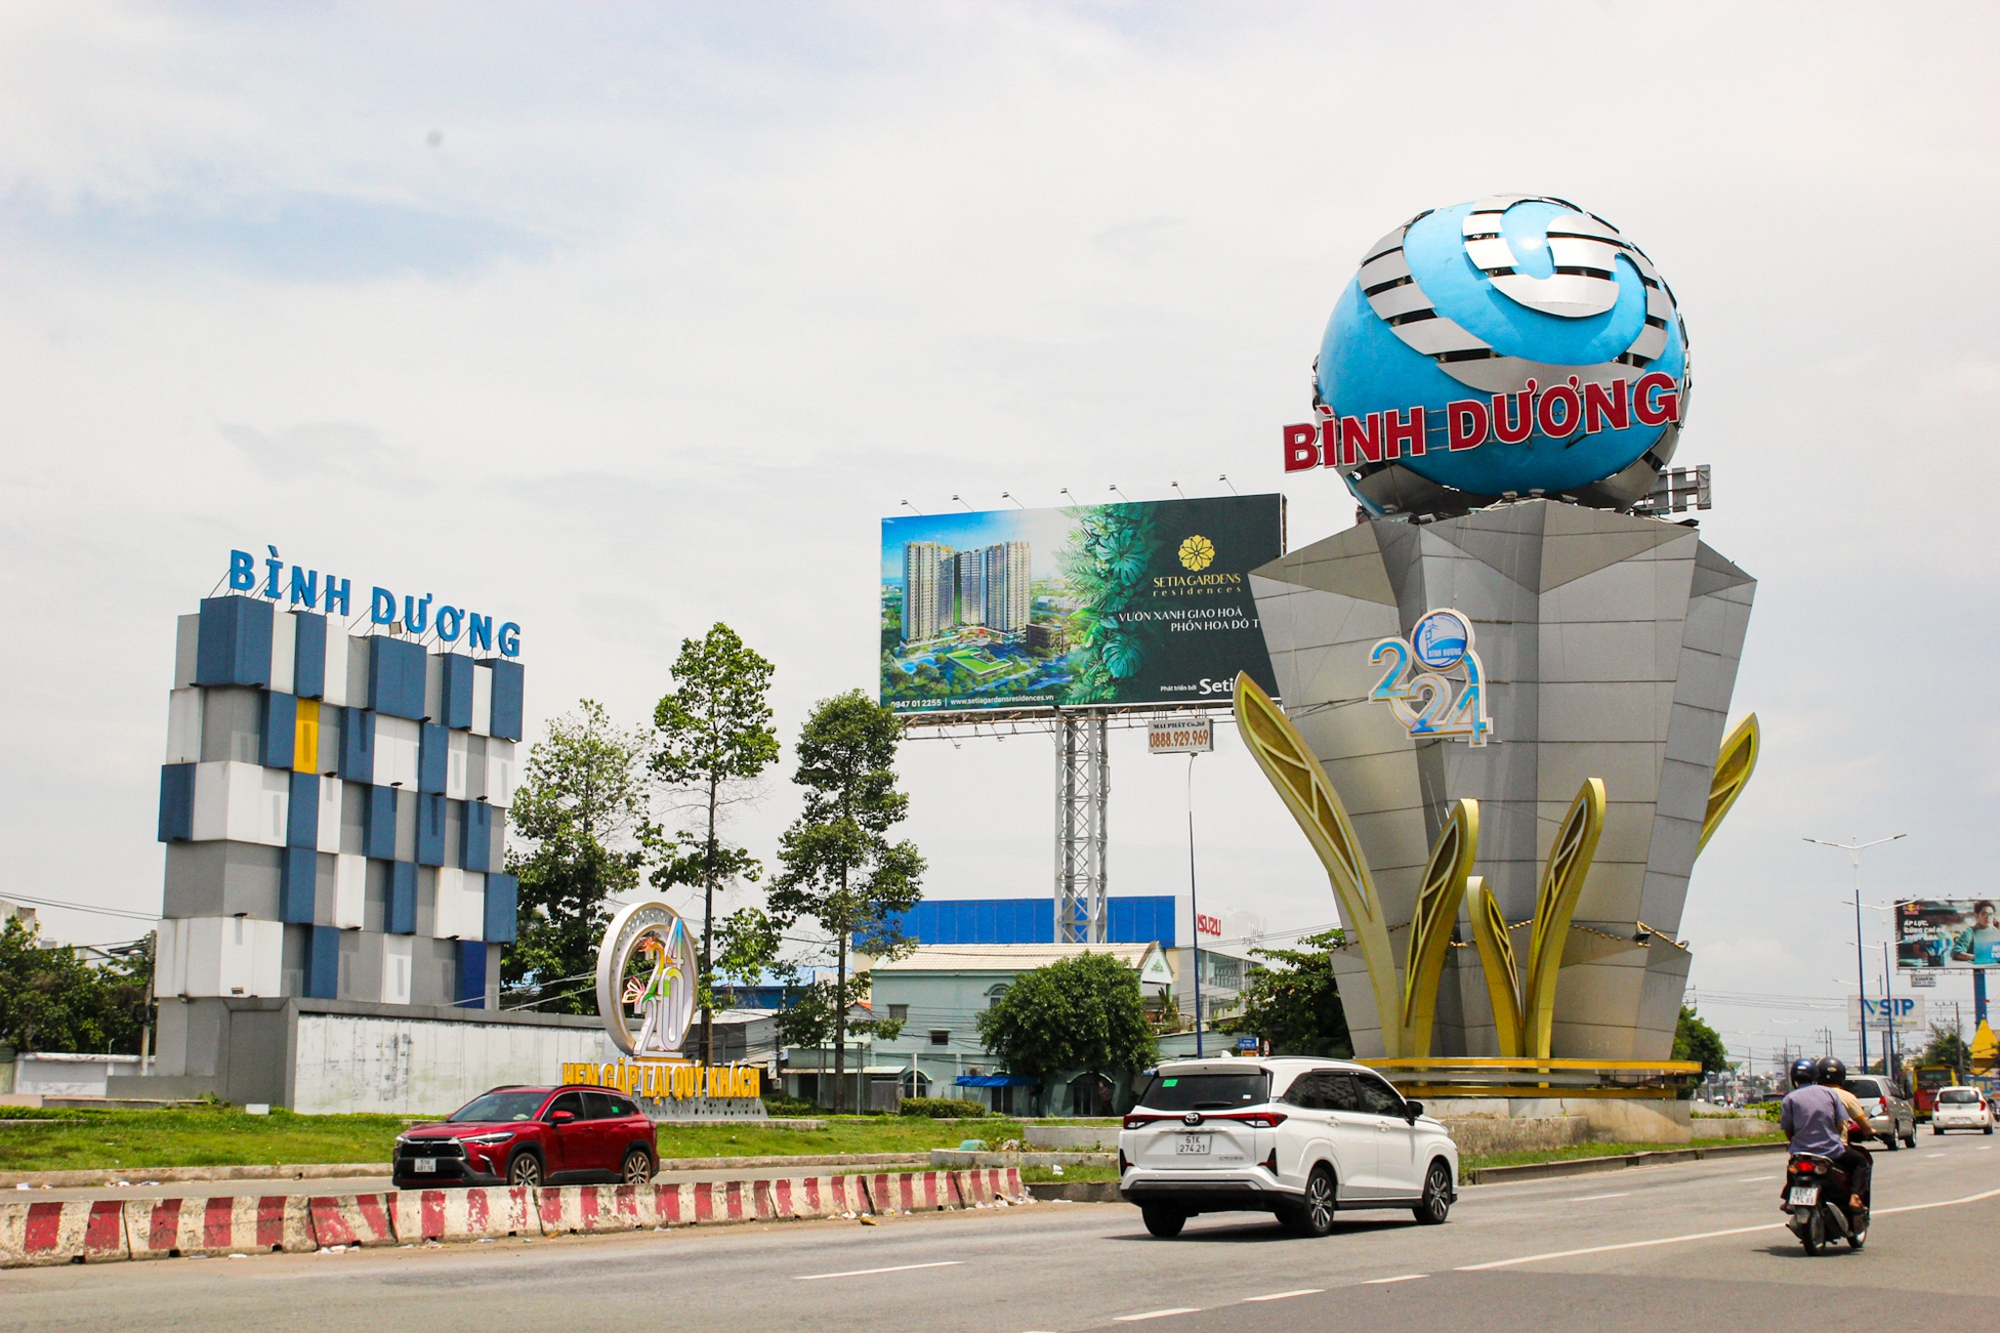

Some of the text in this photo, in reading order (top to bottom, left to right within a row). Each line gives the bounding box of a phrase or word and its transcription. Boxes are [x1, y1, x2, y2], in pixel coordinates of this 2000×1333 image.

[1283, 371, 1681, 474] BÌNH DƯƠNG
[1152, 586, 1242, 597] residences
[229, 545, 521, 657] BÌNH DƯƠNG
[1153, 610, 1185, 620] XANH
[1187, 608, 1215, 619] GIAO
[1204, 619, 1229, 630] HOA
[1252, 618, 1260, 629] T
[1199, 677, 1234, 695] Seti
[911, 700, 920, 708] 01
[922, 698, 942, 707] 2255
[951, 694, 1054, 706] www.setiagardensresidences.vn
[1149, 729, 1209, 748] 0888.929.969
[1197, 913, 1222, 937] ISUZU
[673, 1060, 704, 1100] QUÝ
[708, 1061, 760, 1098] KHÁCH
[1186, 1135, 1200, 1143] 61K
